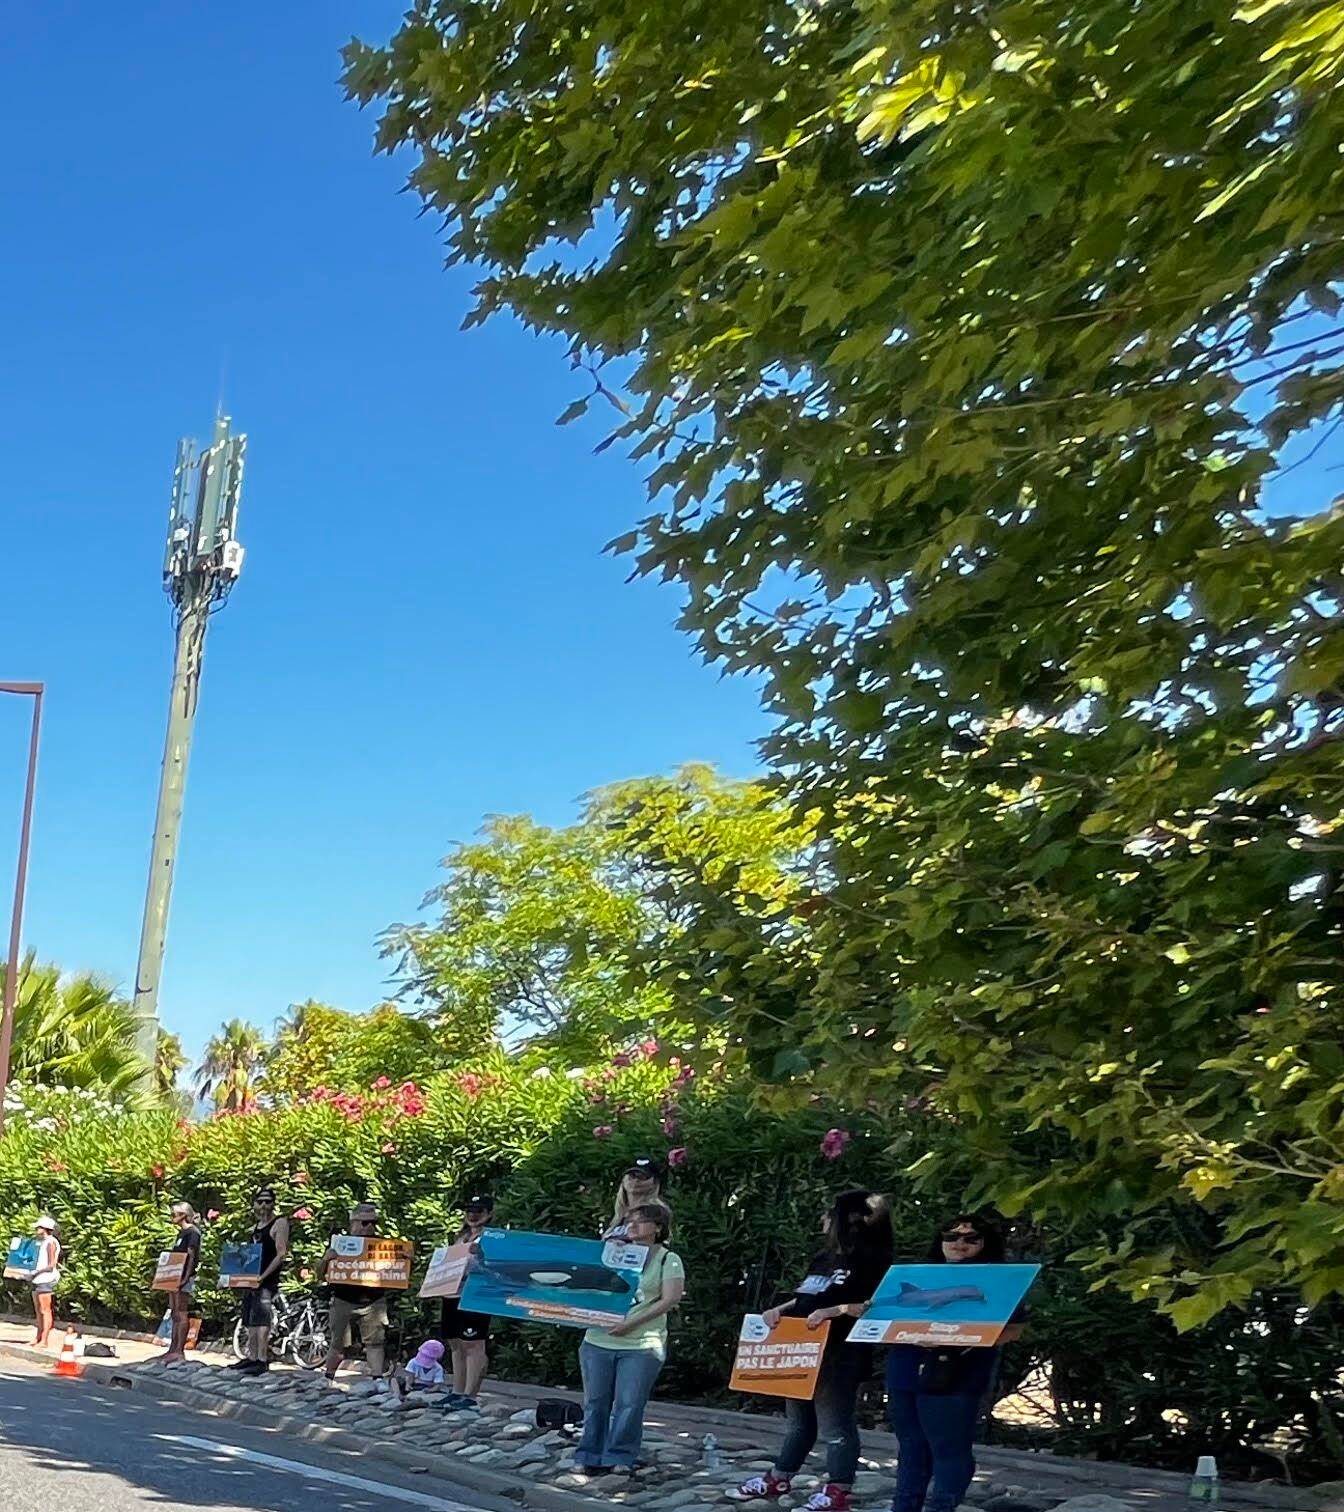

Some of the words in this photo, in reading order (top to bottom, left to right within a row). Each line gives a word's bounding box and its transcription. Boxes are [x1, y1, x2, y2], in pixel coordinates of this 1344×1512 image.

[735, 1357, 759, 1369] PAS
[759, 1357, 775, 1369] LE
[776, 1355, 819, 1369] JAPON
